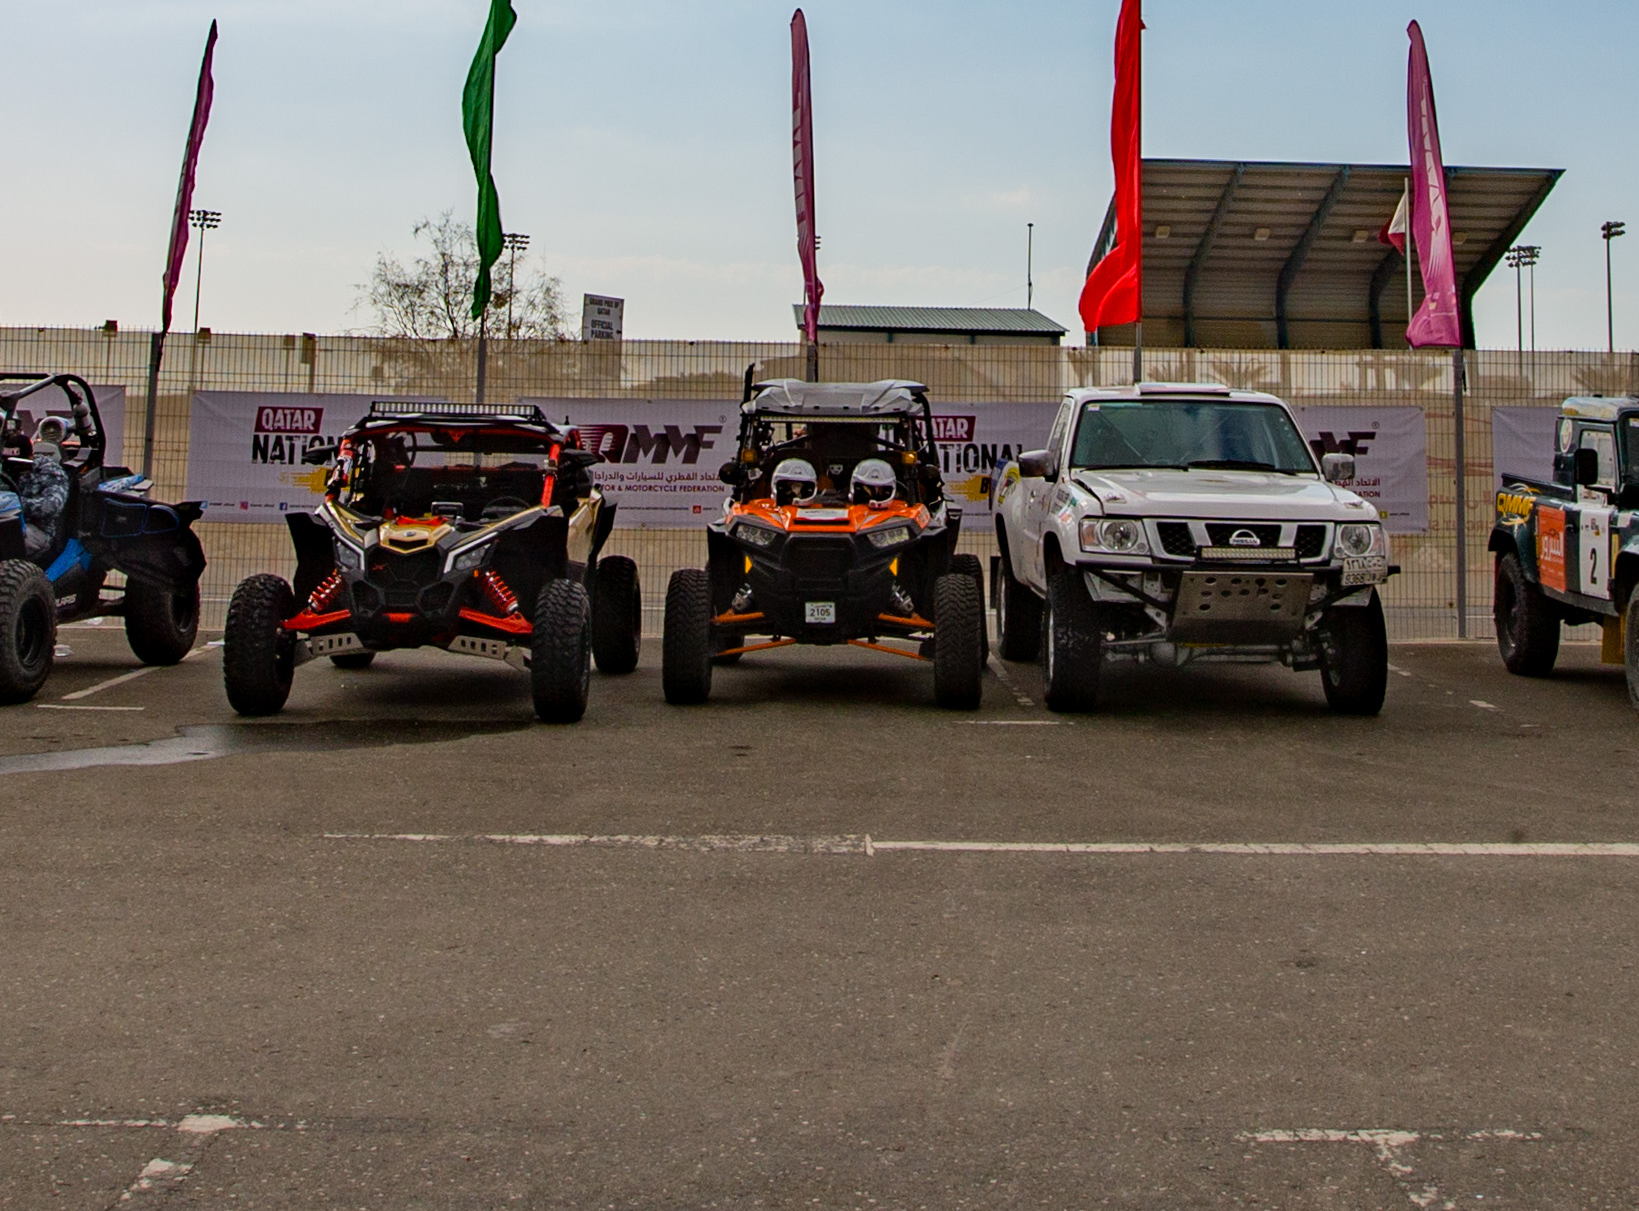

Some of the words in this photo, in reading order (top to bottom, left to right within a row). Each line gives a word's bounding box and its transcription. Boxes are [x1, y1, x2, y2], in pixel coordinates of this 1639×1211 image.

[591, 319, 614, 331] OFFICIAL
[591, 329, 614, 340] PARKING
[261, 407, 316, 431] QATAR
[617, 484, 623, 492] &
[625, 484, 677, 492] MOTORCYCLE
[680, 485, 725, 493] FEDERATION
[1497, 493, 1536, 517] QMMF
[1589, 547, 1598, 585] 2
[810, 608, 831, 617] 2105
